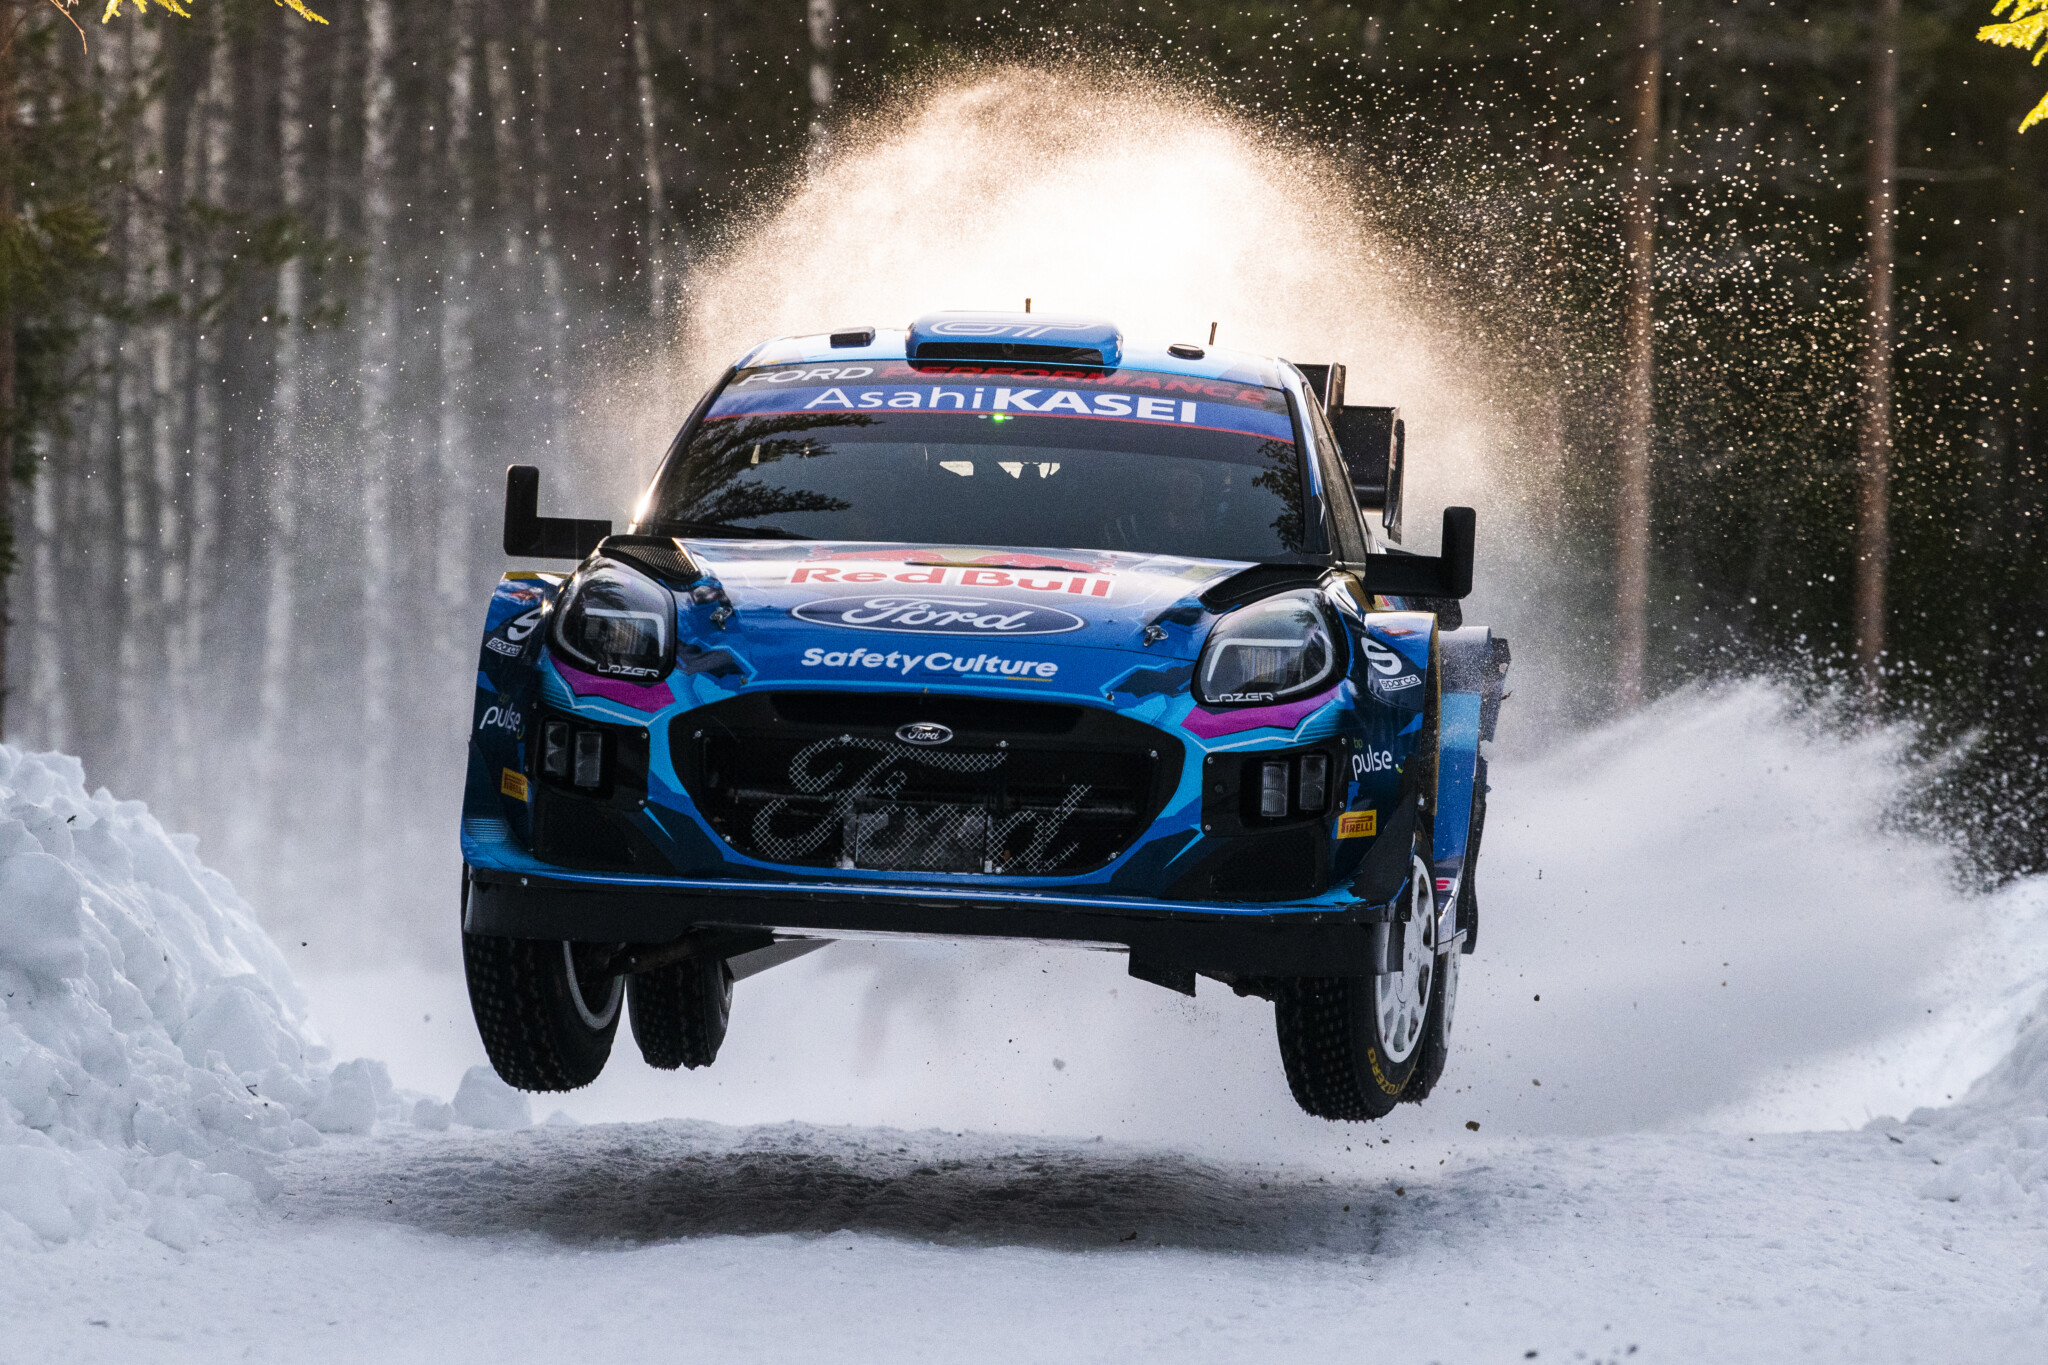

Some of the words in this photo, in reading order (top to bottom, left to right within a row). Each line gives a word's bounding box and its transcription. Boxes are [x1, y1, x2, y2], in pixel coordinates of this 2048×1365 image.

[737, 366, 874, 387] FORD
[877, 365, 1268, 404] PERFORMANCE
[791, 567, 947, 584] Red
[961, 570, 1111, 598] Bull
[841, 599, 1035, 631] Ford
[597, 663, 660, 678] LAZER
[801, 648, 1058, 678] SafetyCulture
[1205, 692, 1274, 703] LAZER
[1381, 675, 1419, 690] sparco
[479, 702, 521, 732] pulse
[907, 723, 941, 740] Ford
[1352, 744, 1393, 781] pulse
[752, 737, 1093, 874] Ford
[1341, 815, 1374, 834] PIRELLI
